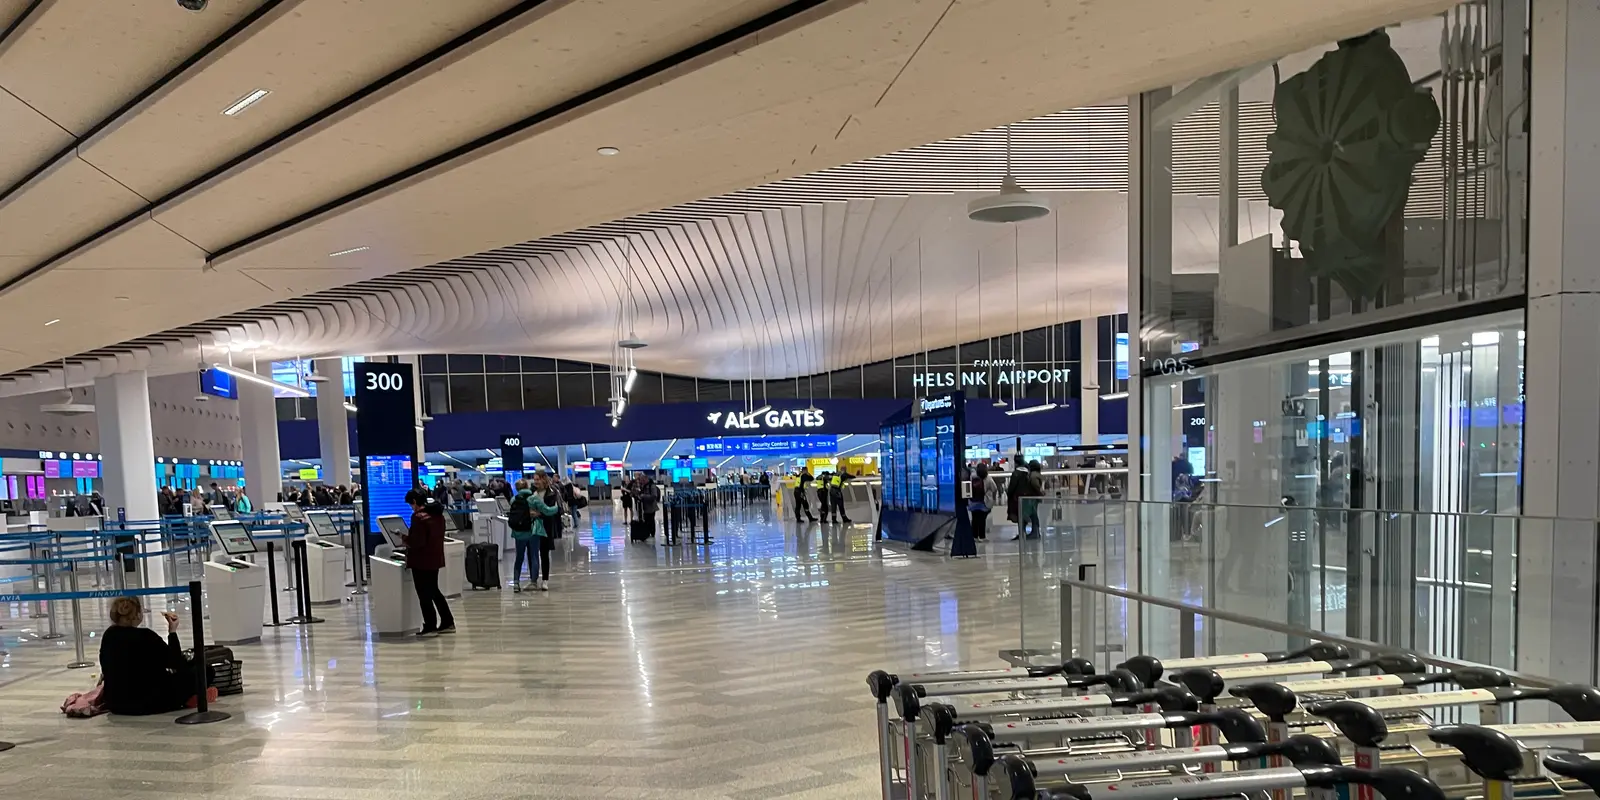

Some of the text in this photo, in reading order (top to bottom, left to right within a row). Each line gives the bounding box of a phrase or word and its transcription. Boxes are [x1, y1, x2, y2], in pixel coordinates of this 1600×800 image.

[366, 373, 403, 390] 300
[913, 369, 1071, 387] HELSNK AIRPORT
[724, 409, 825, 429] ALL GATES
[1190, 418, 1206, 426] 200
[504, 438, 520, 447] 400
[88, 590, 124, 598] FINAVIA
